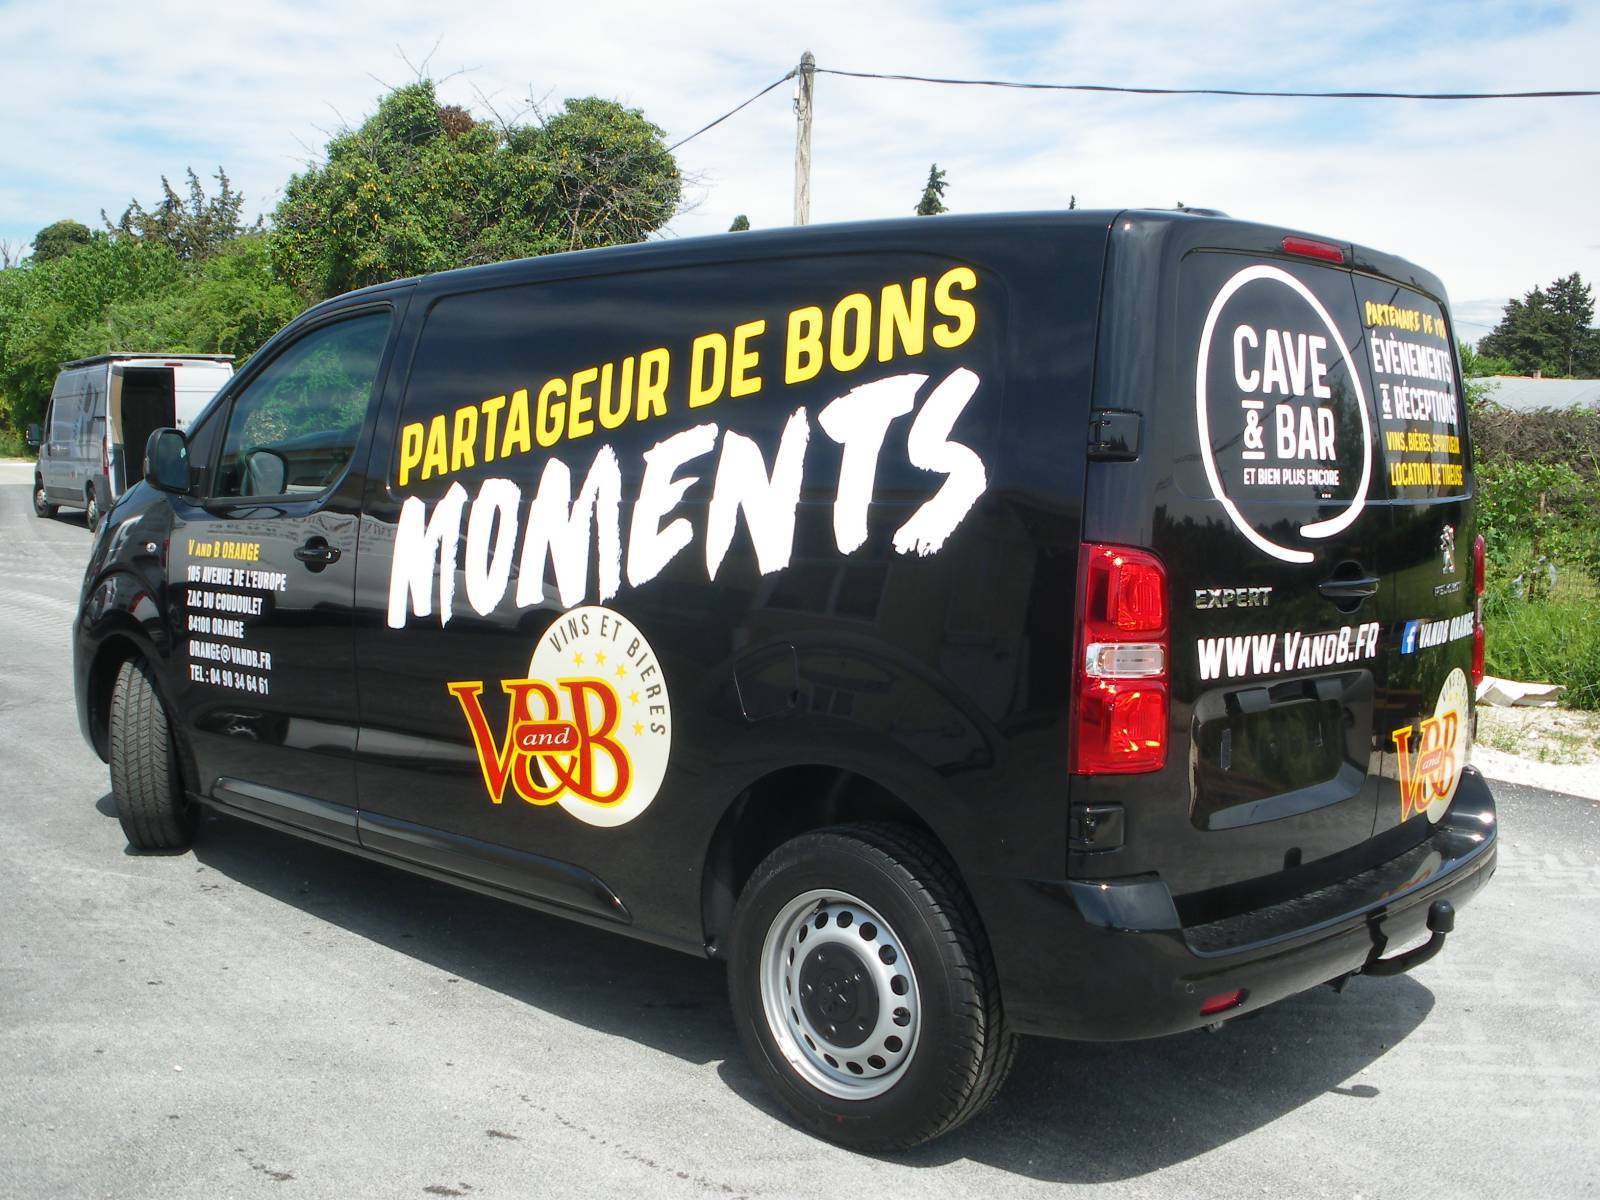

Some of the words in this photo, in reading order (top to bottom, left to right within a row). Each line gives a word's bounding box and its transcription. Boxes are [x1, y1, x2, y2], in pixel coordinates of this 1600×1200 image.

[1233, 324, 1331, 399] CAVE
[399, 347, 670, 486] PARTAGEUR
[688, 319, 766, 409] DE
[784, 266, 977, 385] BONS
[1242, 402, 1264, 458] &
[1275, 404, 1337, 461] BAR
[1243, 468, 1256, 485] ET
[1257, 468, 1281, 485] BIEN
[1282, 469, 1305, 486] PLUS
[1306, 470, 1340, 486] ENCORE
[1390, 462, 1432, 486] LOCATION
[387, 367, 987, 629] MOMENTS
[214, 541, 221, 558] B
[222, 542, 260, 561] ORANGE
[202, 566, 233, 586] AVENUE
[234, 569, 245, 587] DE
[245, 570, 287, 592] L'EUROPE
[187, 590, 202, 607] ZAC
[203, 592, 214, 609] DU
[215, 593, 263, 616] COUDOULET
[1195, 587, 1273, 610] EXPERT
[188, 615, 210, 634] 84100
[212, 617, 244, 639] ORANGE
[210, 667, 221, 686] 04
[222, 670, 233, 688] 90
[234, 672, 245, 690] 34
[246, 674, 257, 692] 64
[258, 678, 269, 695] 61
[549, 613, 590, 653] VINS
[600, 615, 622, 642] ET
[626, 637, 666, 736] BIERES
[522, 727, 571, 746] and
